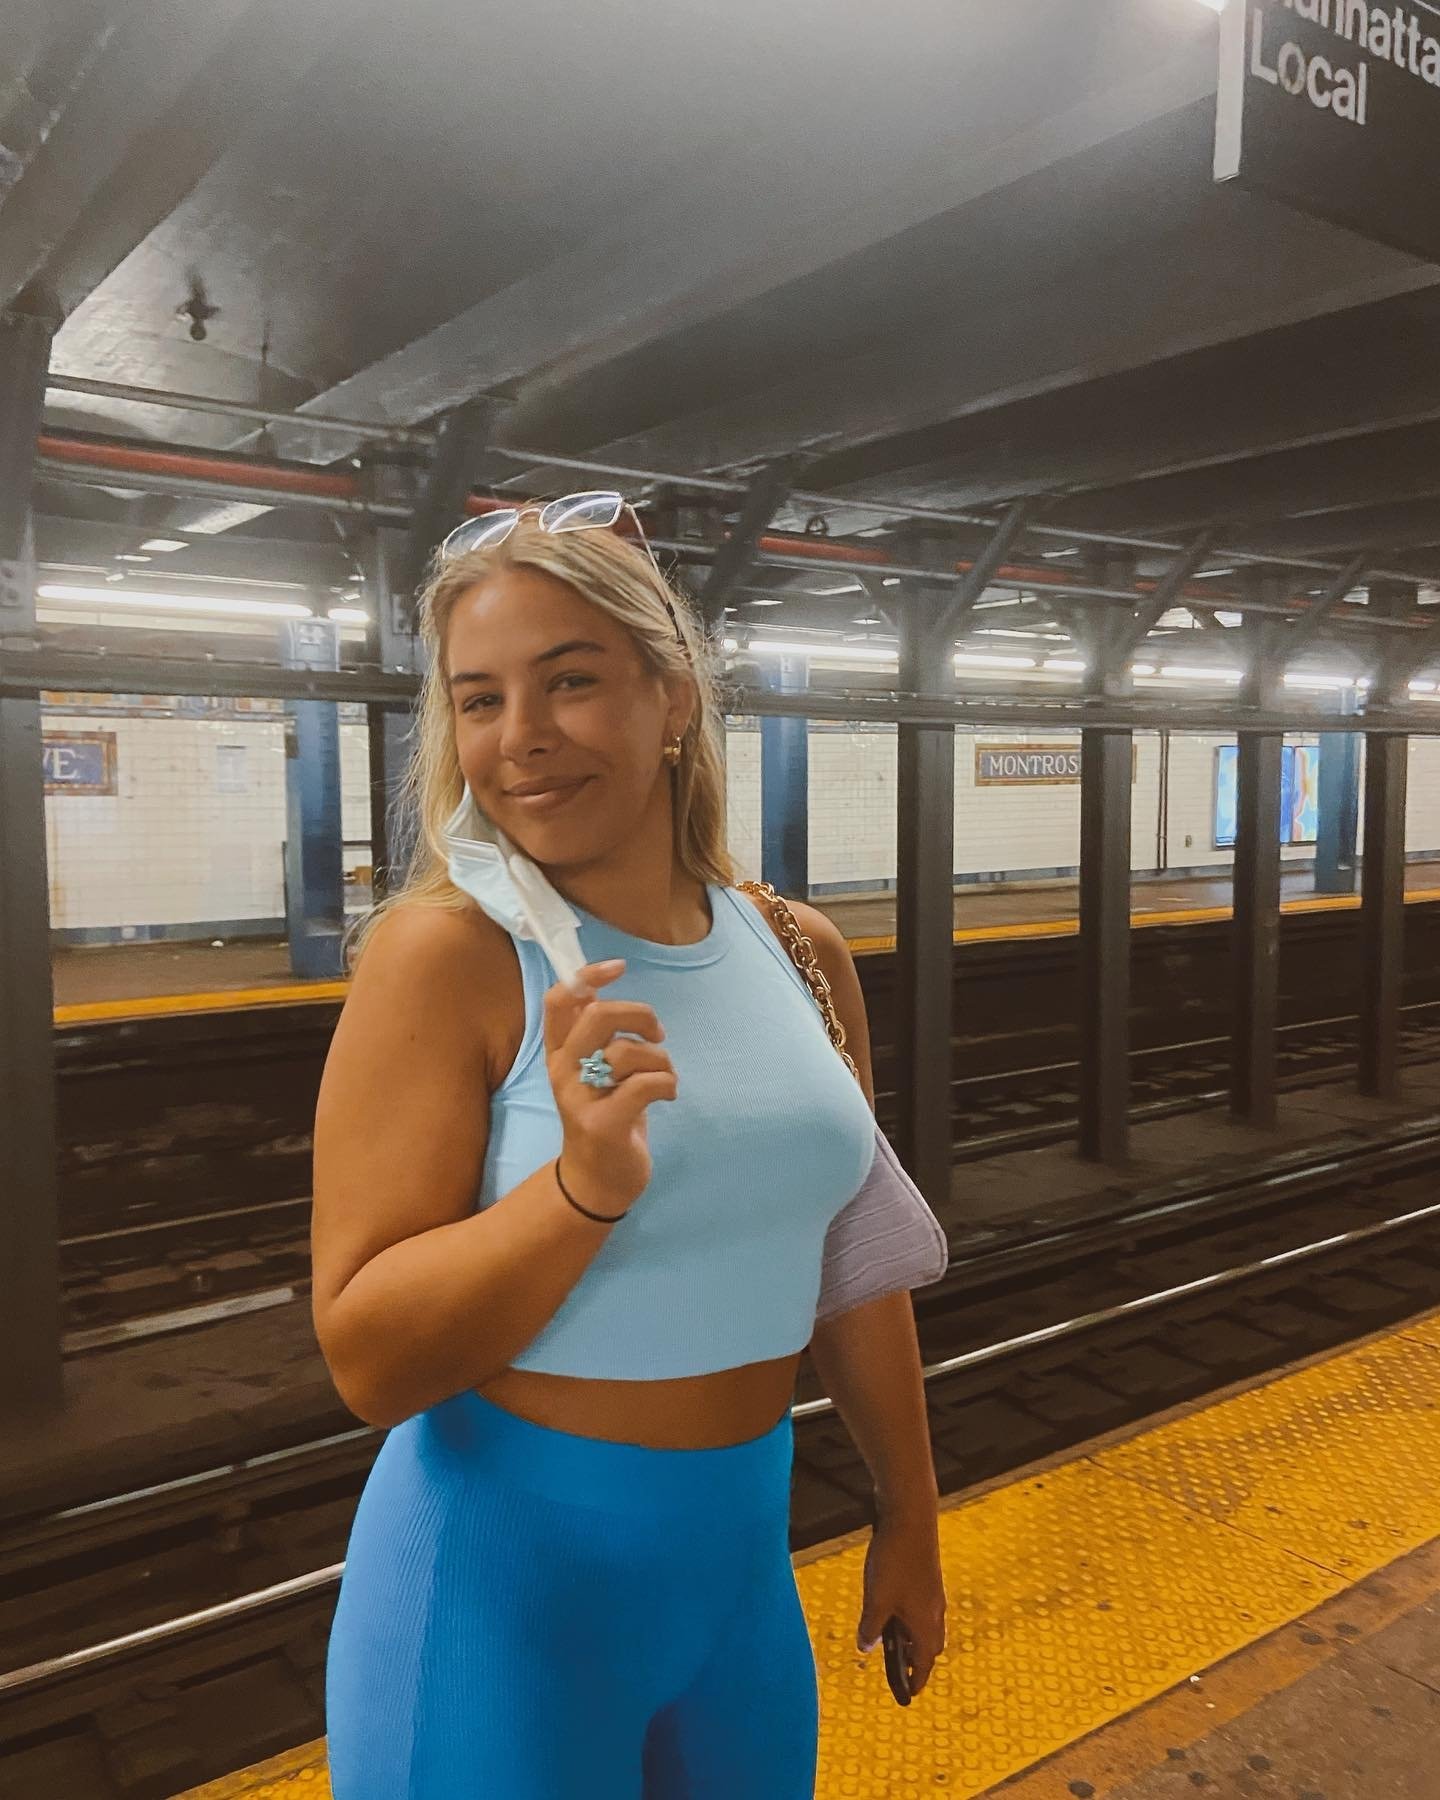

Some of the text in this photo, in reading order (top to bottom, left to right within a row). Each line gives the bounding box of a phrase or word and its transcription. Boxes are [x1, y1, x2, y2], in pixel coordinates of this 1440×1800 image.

[1251, 8, 1367, 125] Local
[1284, 0, 1440, 87] nhatta
[989, 755, 1079, 776] MONTROS
